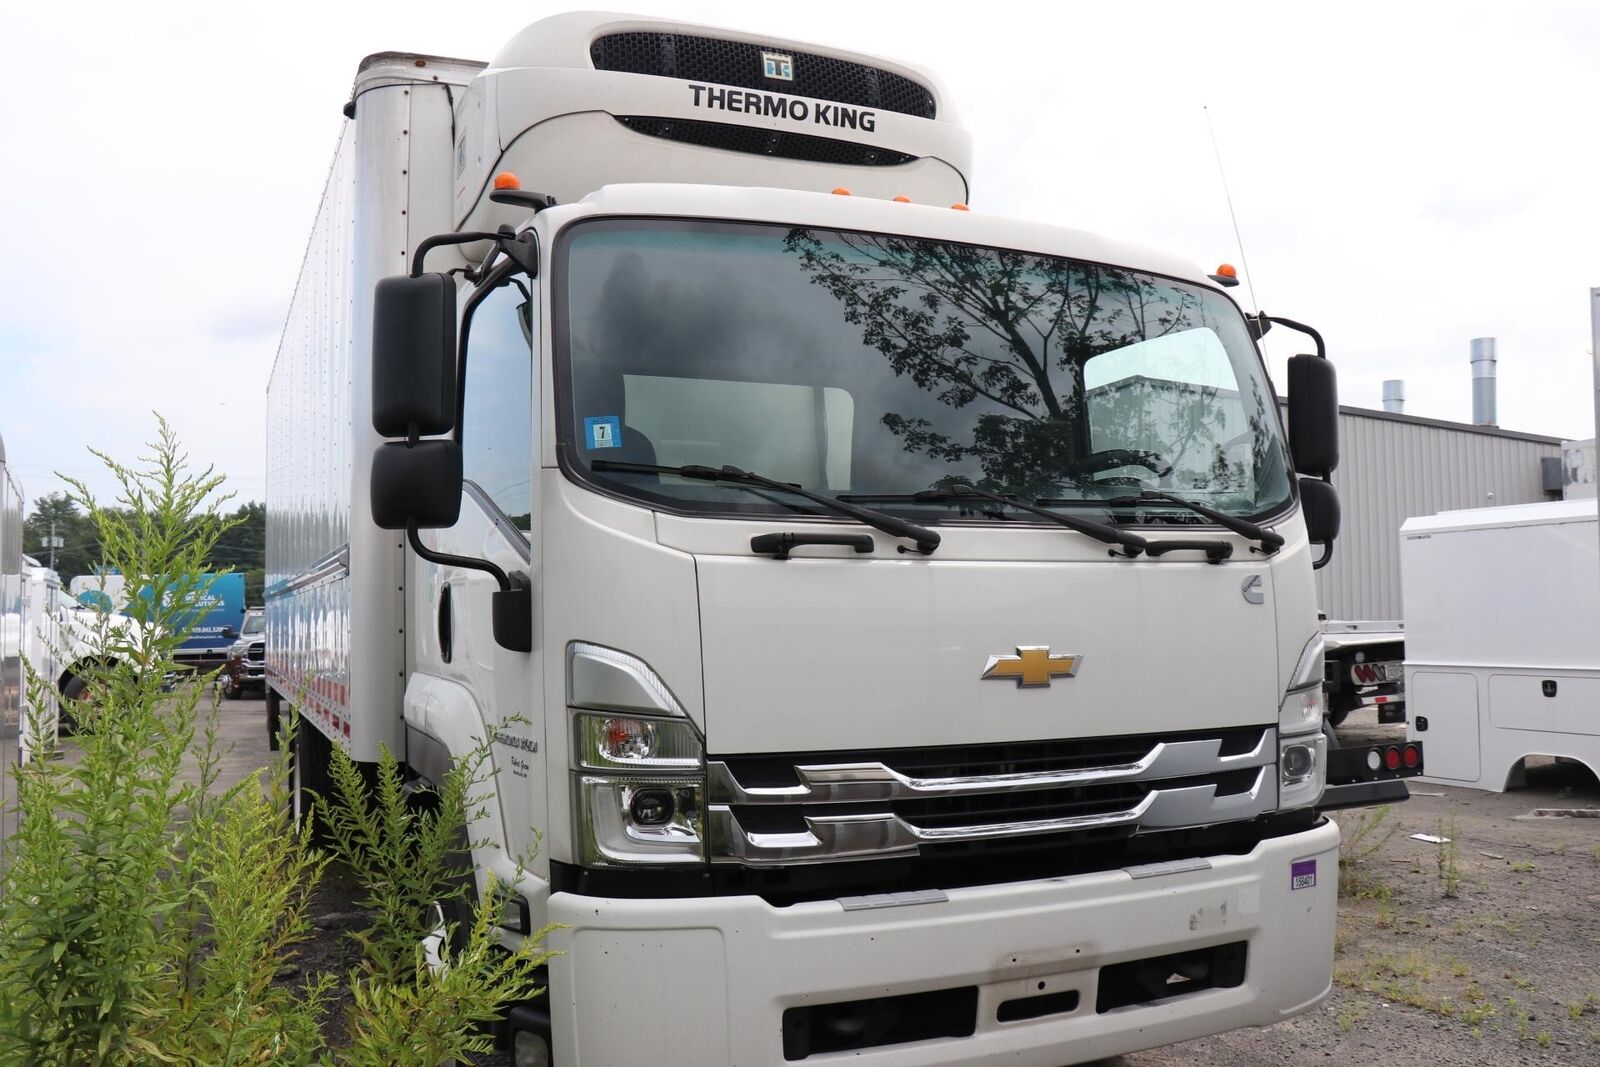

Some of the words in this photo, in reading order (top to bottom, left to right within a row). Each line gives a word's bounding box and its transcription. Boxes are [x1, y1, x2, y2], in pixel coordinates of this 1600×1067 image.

[688, 84, 809, 121] THERMO
[814, 103, 876, 133] KING
[600, 426, 606, 439] 7
